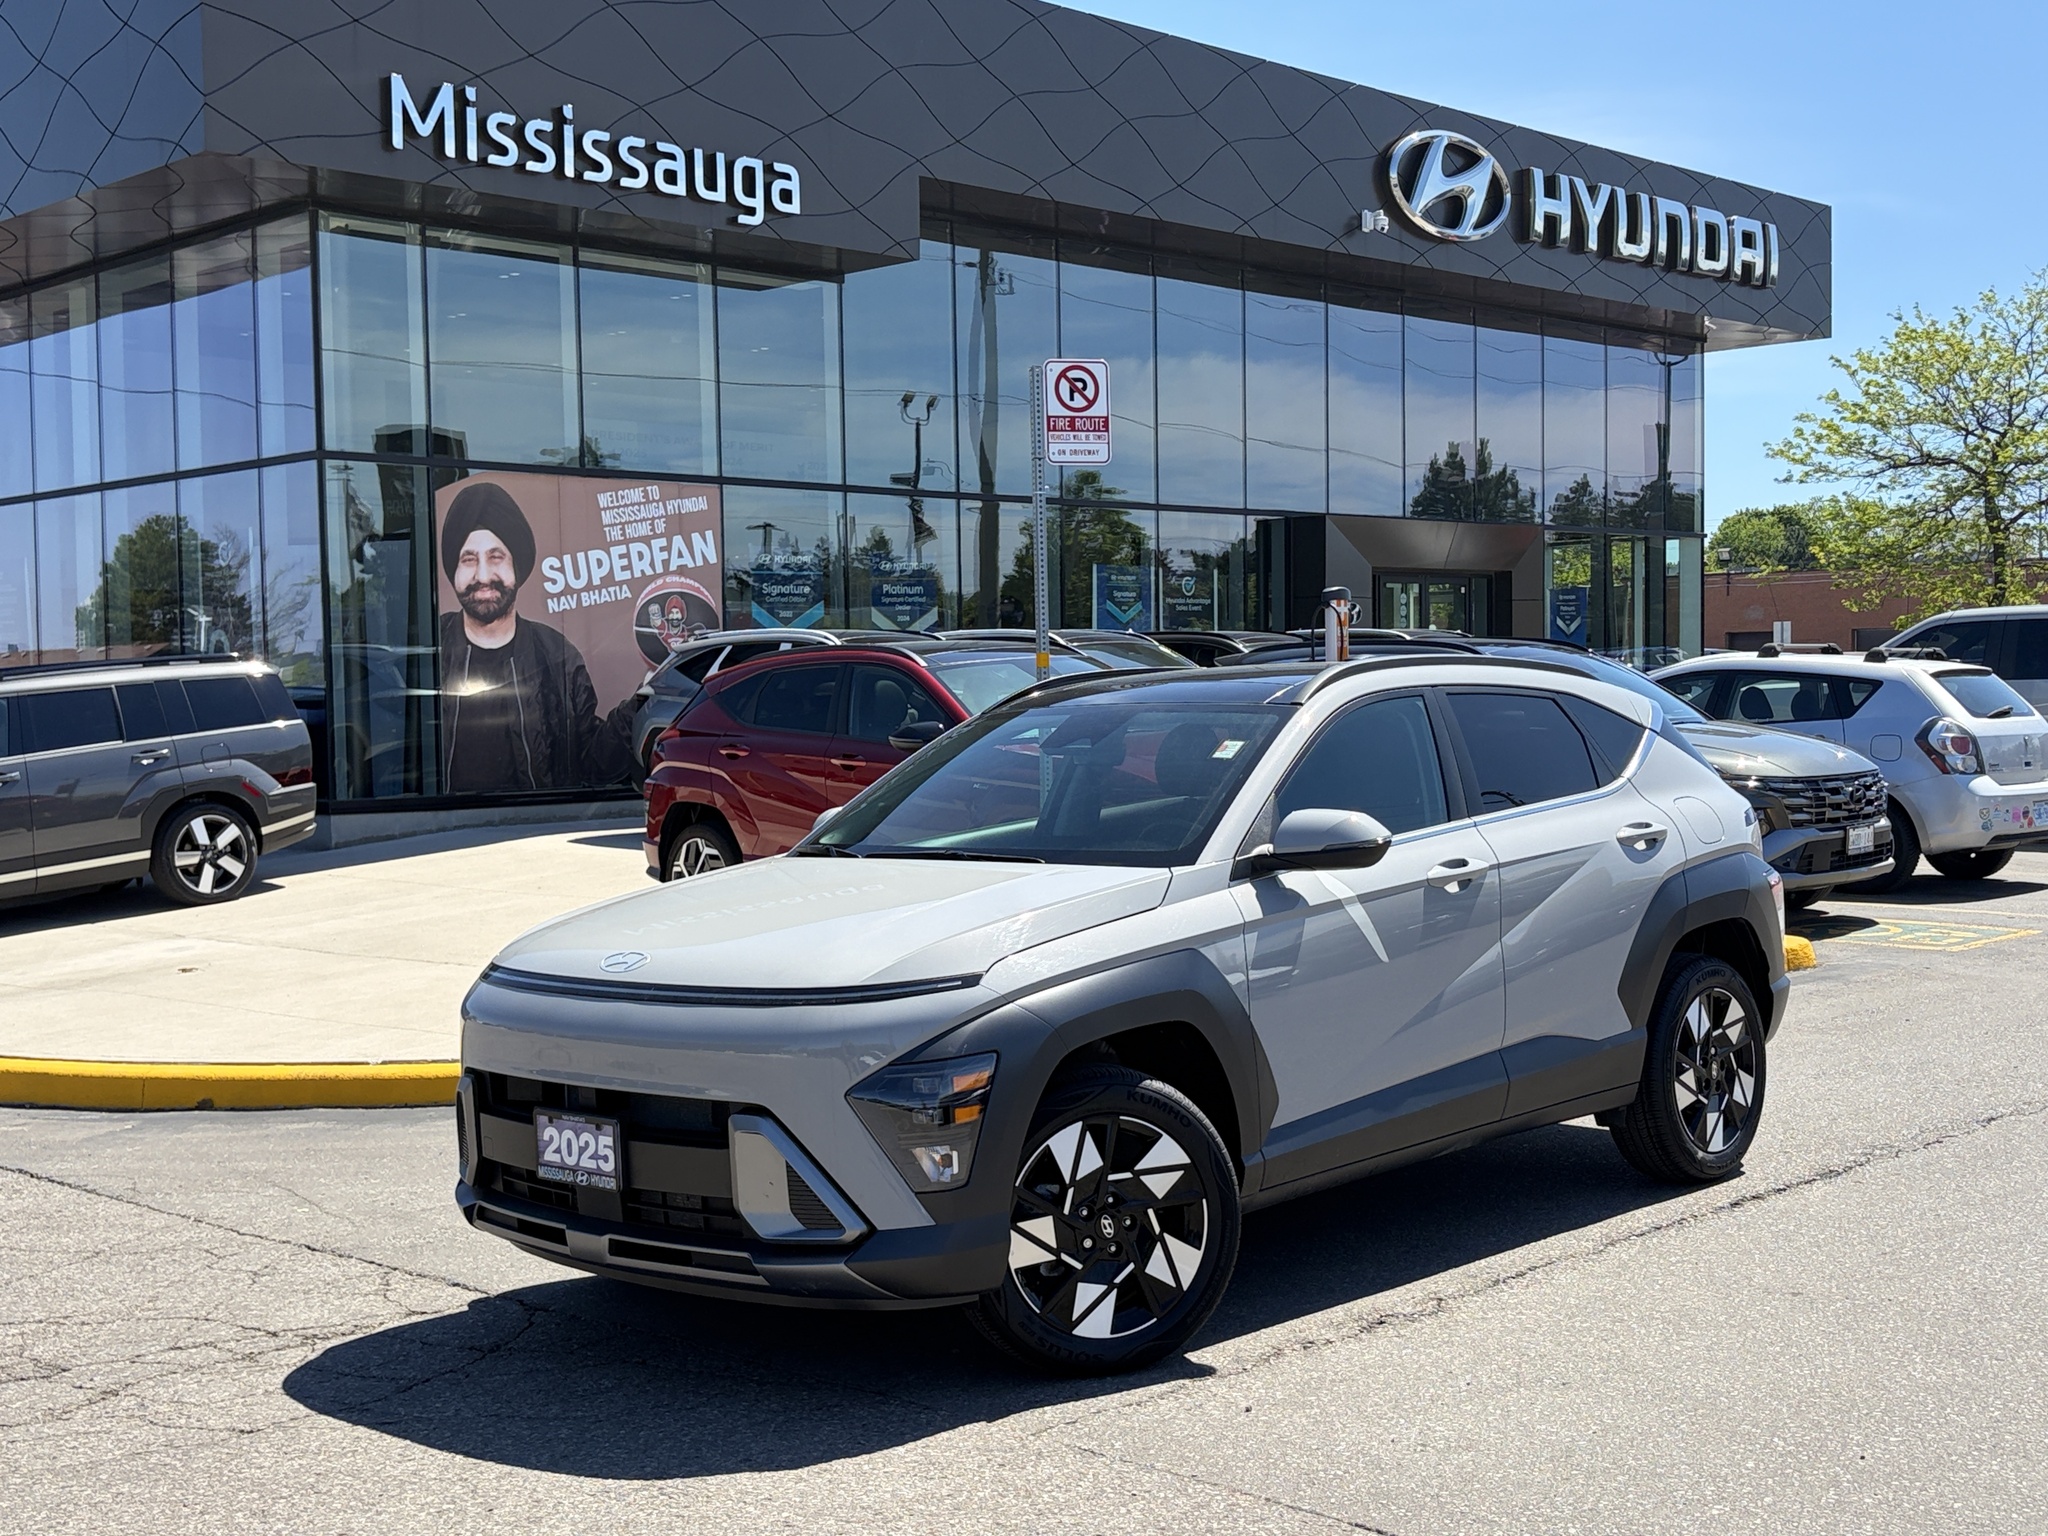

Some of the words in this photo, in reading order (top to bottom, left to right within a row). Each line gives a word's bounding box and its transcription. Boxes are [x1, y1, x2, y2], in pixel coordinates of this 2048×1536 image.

[389, 72, 801, 226] Mississauga
[1528, 166, 1780, 288] HYUNDAI
[1050, 417, 1071, 431] FIRE
[1075, 417, 1106, 431] ROUTE
[1050, 433, 1071, 441] VEHICLES
[1072, 433, 1083, 441] WILL
[1085, 433, 1091, 441] BE
[1092, 433, 1107, 441] TOWED
[1057, 448, 1066, 456] ON
[1069, 448, 1100, 457] DRIVEWAY
[596, 487, 646, 508] WELCOME
[646, 485, 660, 501] TO
[601, 502, 666, 526] MISSISSAUGA
[666, 495, 708, 515] HYUNDAI
[603, 525, 625, 542] THE
[624, 520, 654, 539] HOME
[654, 518, 667, 534] OF
[541, 529, 718, 594] SUPERFAN
[547, 593, 577, 614] NAV
[581, 584, 632, 608] BHATIA
[761, 582, 811, 596] Signature
[881, 596, 904, 604] Signature
[882, 583, 924, 594] Platinum
[1694, 967, 1726, 986] KUMHO
[1126, 1089, 1191, 1128] KUMHO
[543, 1126, 615, 1172] 2025
